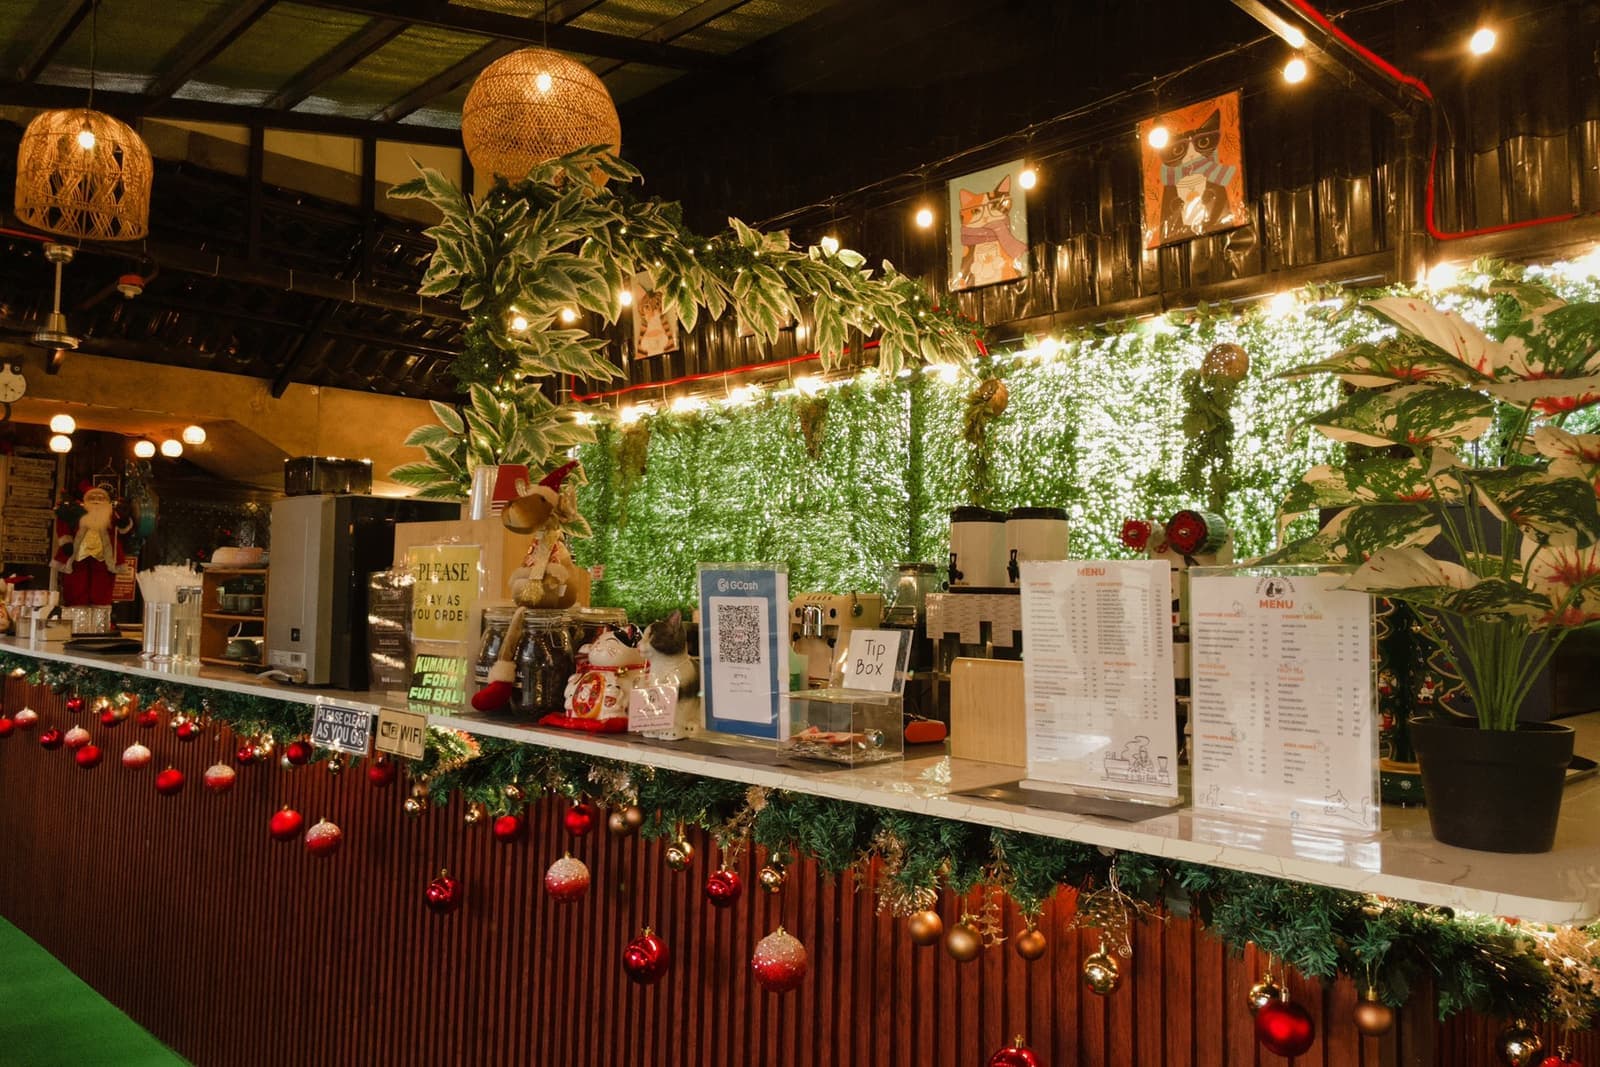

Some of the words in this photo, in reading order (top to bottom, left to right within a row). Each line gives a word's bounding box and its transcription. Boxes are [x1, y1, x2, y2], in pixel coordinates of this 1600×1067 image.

[419, 563, 470, 581] PLEASE
[1077, 567, 1105, 577] MENU
[730, 581, 759, 591] GCash
[425, 594, 442, 606] AY
[447, 594, 460, 606] AS
[1259, 600, 1294, 609] MENU
[434, 609, 470, 622] ORDE
[864, 639, 886, 662] Tip
[855, 659, 884, 676] Box
[409, 686, 432, 700] FUR
[318, 709, 343, 724] PLEASE
[344, 712, 367, 729] CLEAN
[316, 722, 330, 739] AS
[330, 724, 349, 743] YOU
[350, 728, 365, 746] GO
[400, 724, 422, 745] WIFI
